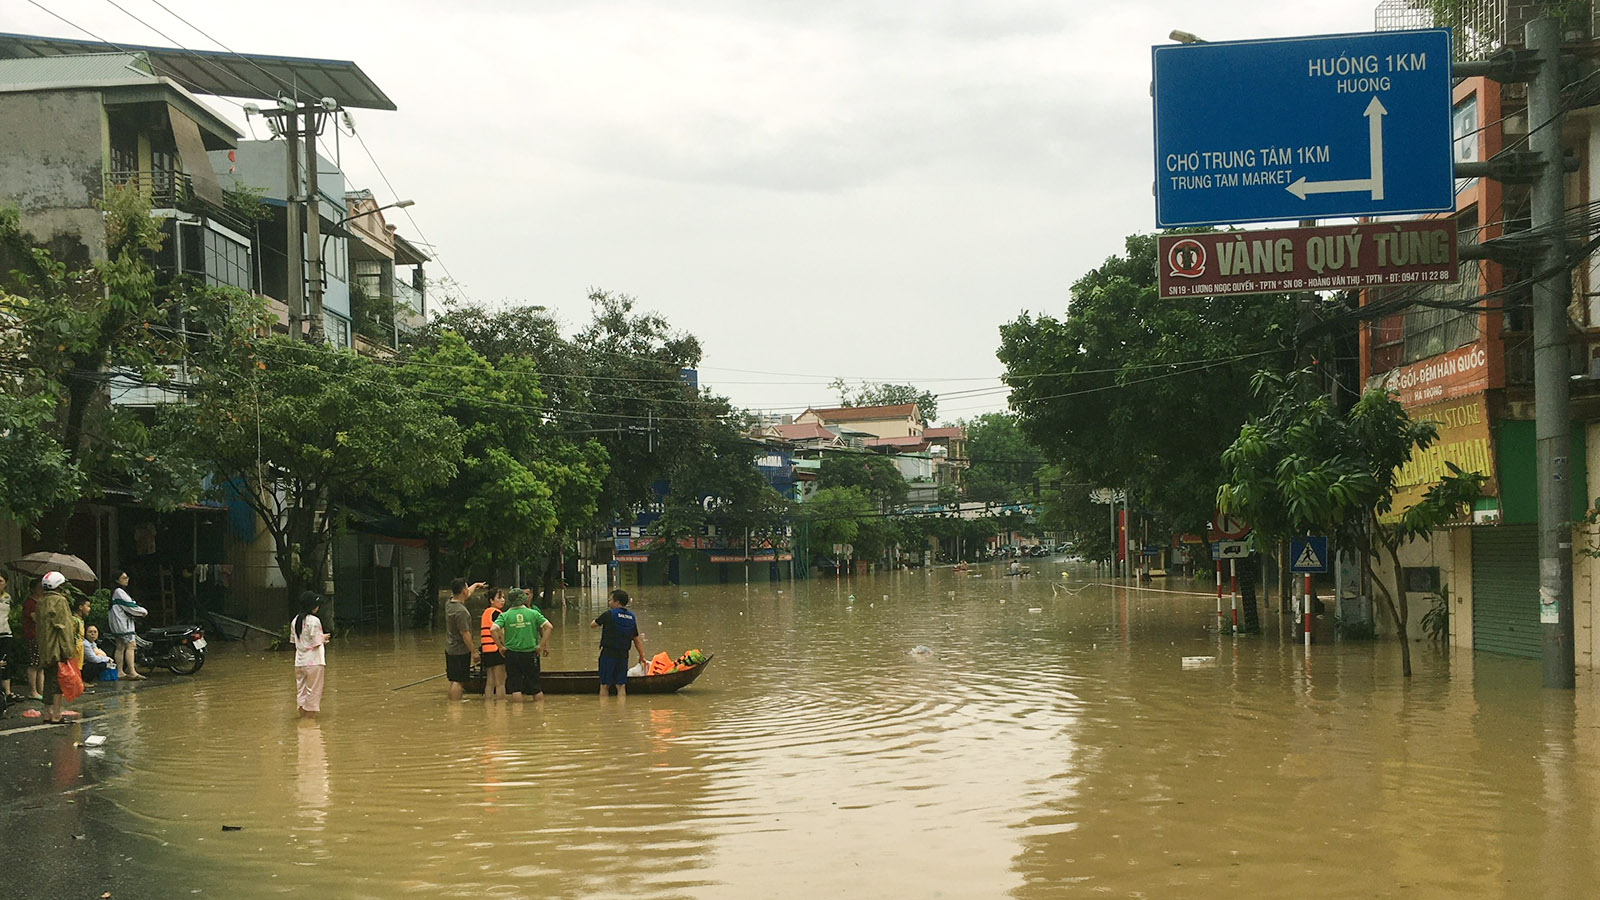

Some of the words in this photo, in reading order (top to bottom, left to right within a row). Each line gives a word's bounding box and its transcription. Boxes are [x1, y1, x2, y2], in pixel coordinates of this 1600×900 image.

[1385, 52, 1427, 73] 1KM
[1337, 76, 1391, 94] HUONG
[1166, 150, 1200, 173] CHỢ
[1202, 149, 1256, 169] TRUNG
[1260, 145, 1292, 166] TÂM
[1297, 145, 1330, 164] 1KM
[1171, 174, 1212, 191] TRUNG
[1214, 173, 1239, 188] TAM
[1242, 169, 1292, 186] MARKET
[1216, 234, 1293, 276] VÀNG
[1306, 228, 1363, 274] QUÝ
[1373, 225, 1450, 268] TÙNG
[1260, 280, 1277, 290] TPTN
[1308, 276, 1331, 287] HOÀNG
[1365, 274, 1383, 283] TPTN
[1401, 271, 1419, 281] 0947
[1421, 271, 1428, 281] 11
[1429, 271, 1439, 280] 22
[1437, 356, 1456, 378] HÀN
[1457, 345, 1485, 373] QUỐC
[1444, 402, 1481, 430] STORE
